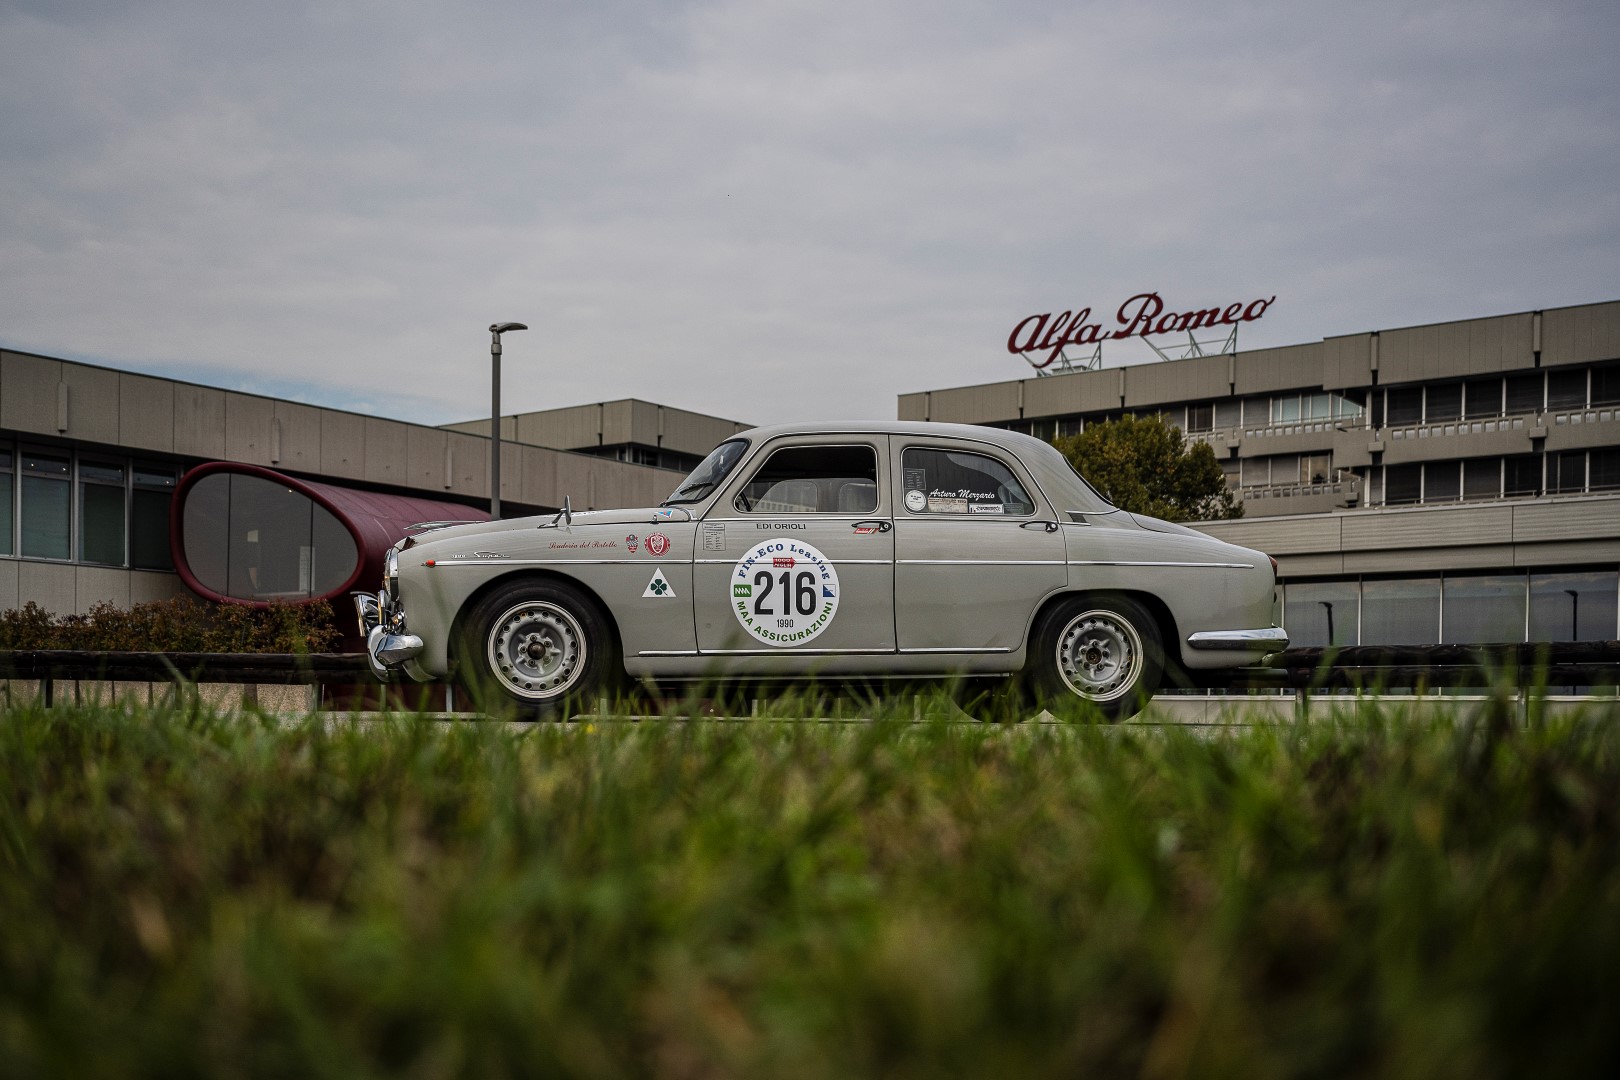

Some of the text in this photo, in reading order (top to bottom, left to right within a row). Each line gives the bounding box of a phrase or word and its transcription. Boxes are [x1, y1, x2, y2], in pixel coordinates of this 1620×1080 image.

[1007, 292, 1276, 368] Alfa Romeo
[929, 488, 995, 501] Arturo Merzario
[738, 543, 831, 580] FIN-ECO Leasing
[754, 570, 817, 616] 216
[736, 600, 834, 642] MAA ASSICURAZIONI
[776, 619, 794, 628] 1990
